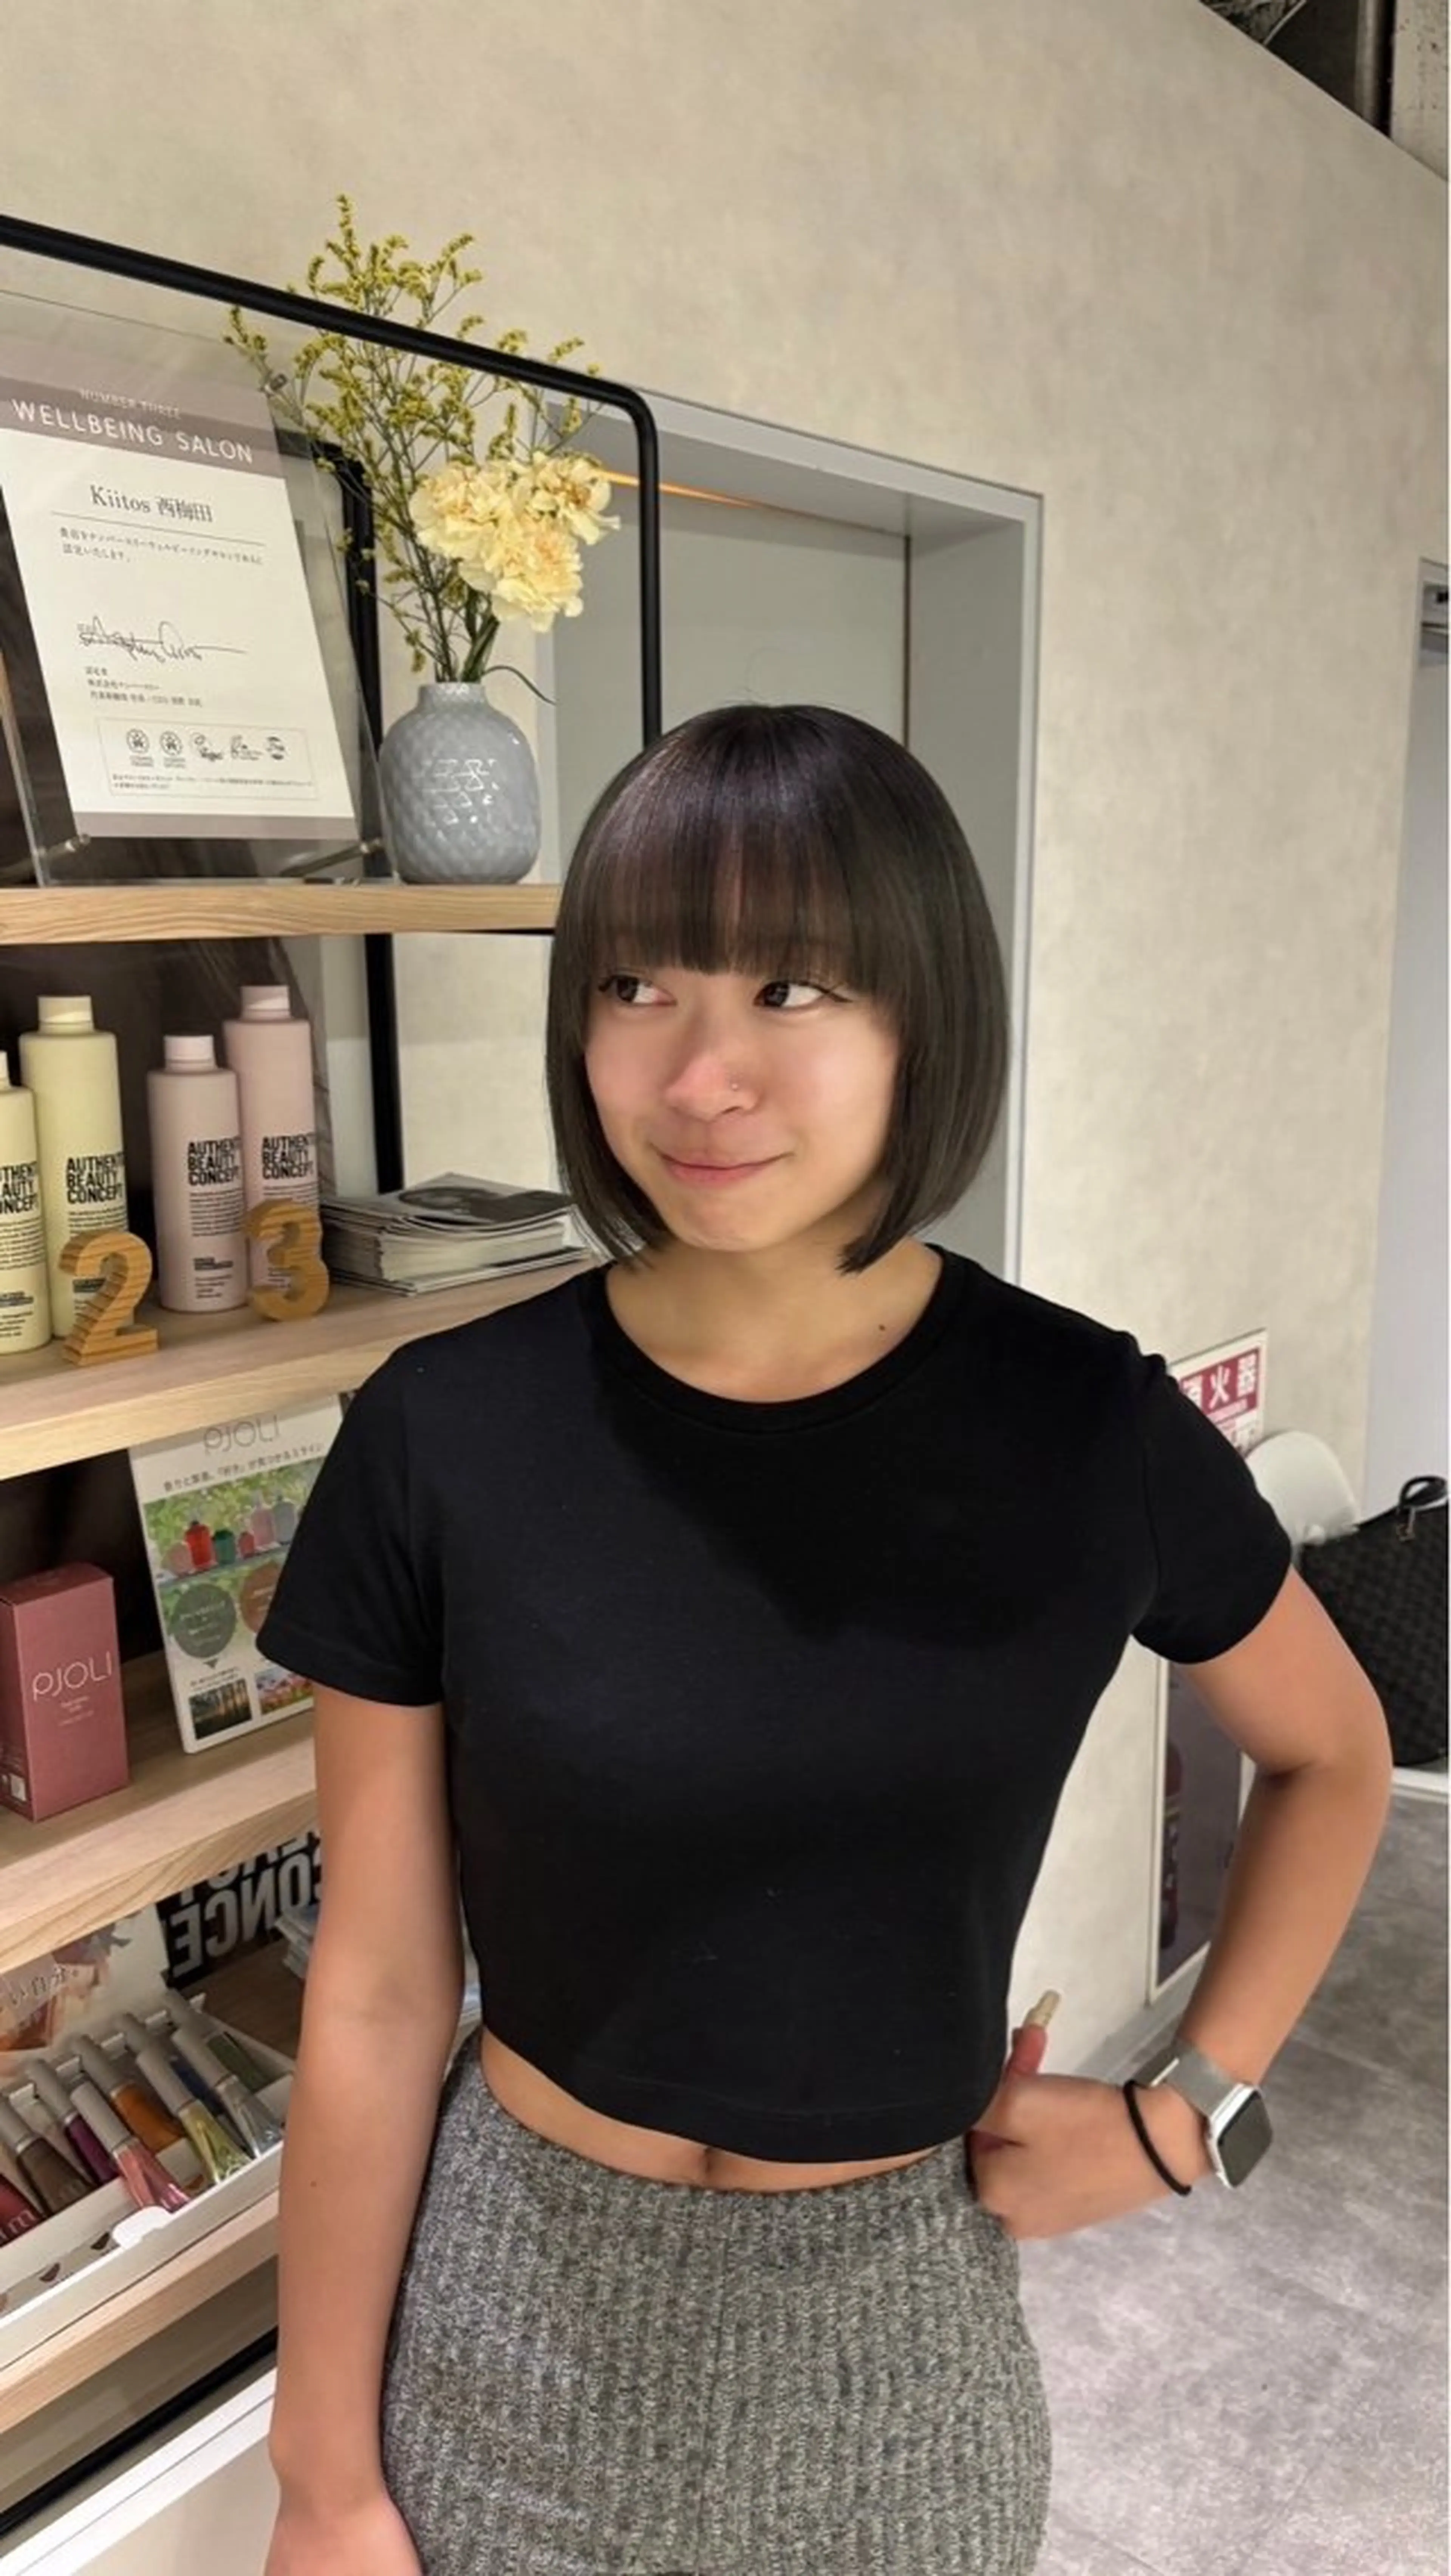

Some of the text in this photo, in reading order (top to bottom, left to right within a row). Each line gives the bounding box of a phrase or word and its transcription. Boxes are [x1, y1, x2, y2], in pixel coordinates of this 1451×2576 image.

[11, 398, 253, 463] WELLBEING SALON
[90, 484, 151, 513] Kiitos
[187, 1152, 235, 1171] BEAUTY
[262, 1149, 308, 1168] BEAUTY
[263, 1162, 314, 1180] CONCEPT
[67, 1170, 118, 1189] BEAUTY
[188, 1166, 239, 1186] CONCEPT
[67, 1183, 124, 1204] CONCEPT
[245, 1198, 328, 1322] 3
[59, 1231, 158, 1366] 2
[203, 1415, 280, 1456] PJOLI
[32, 1650, 112, 1701] PJOLI
